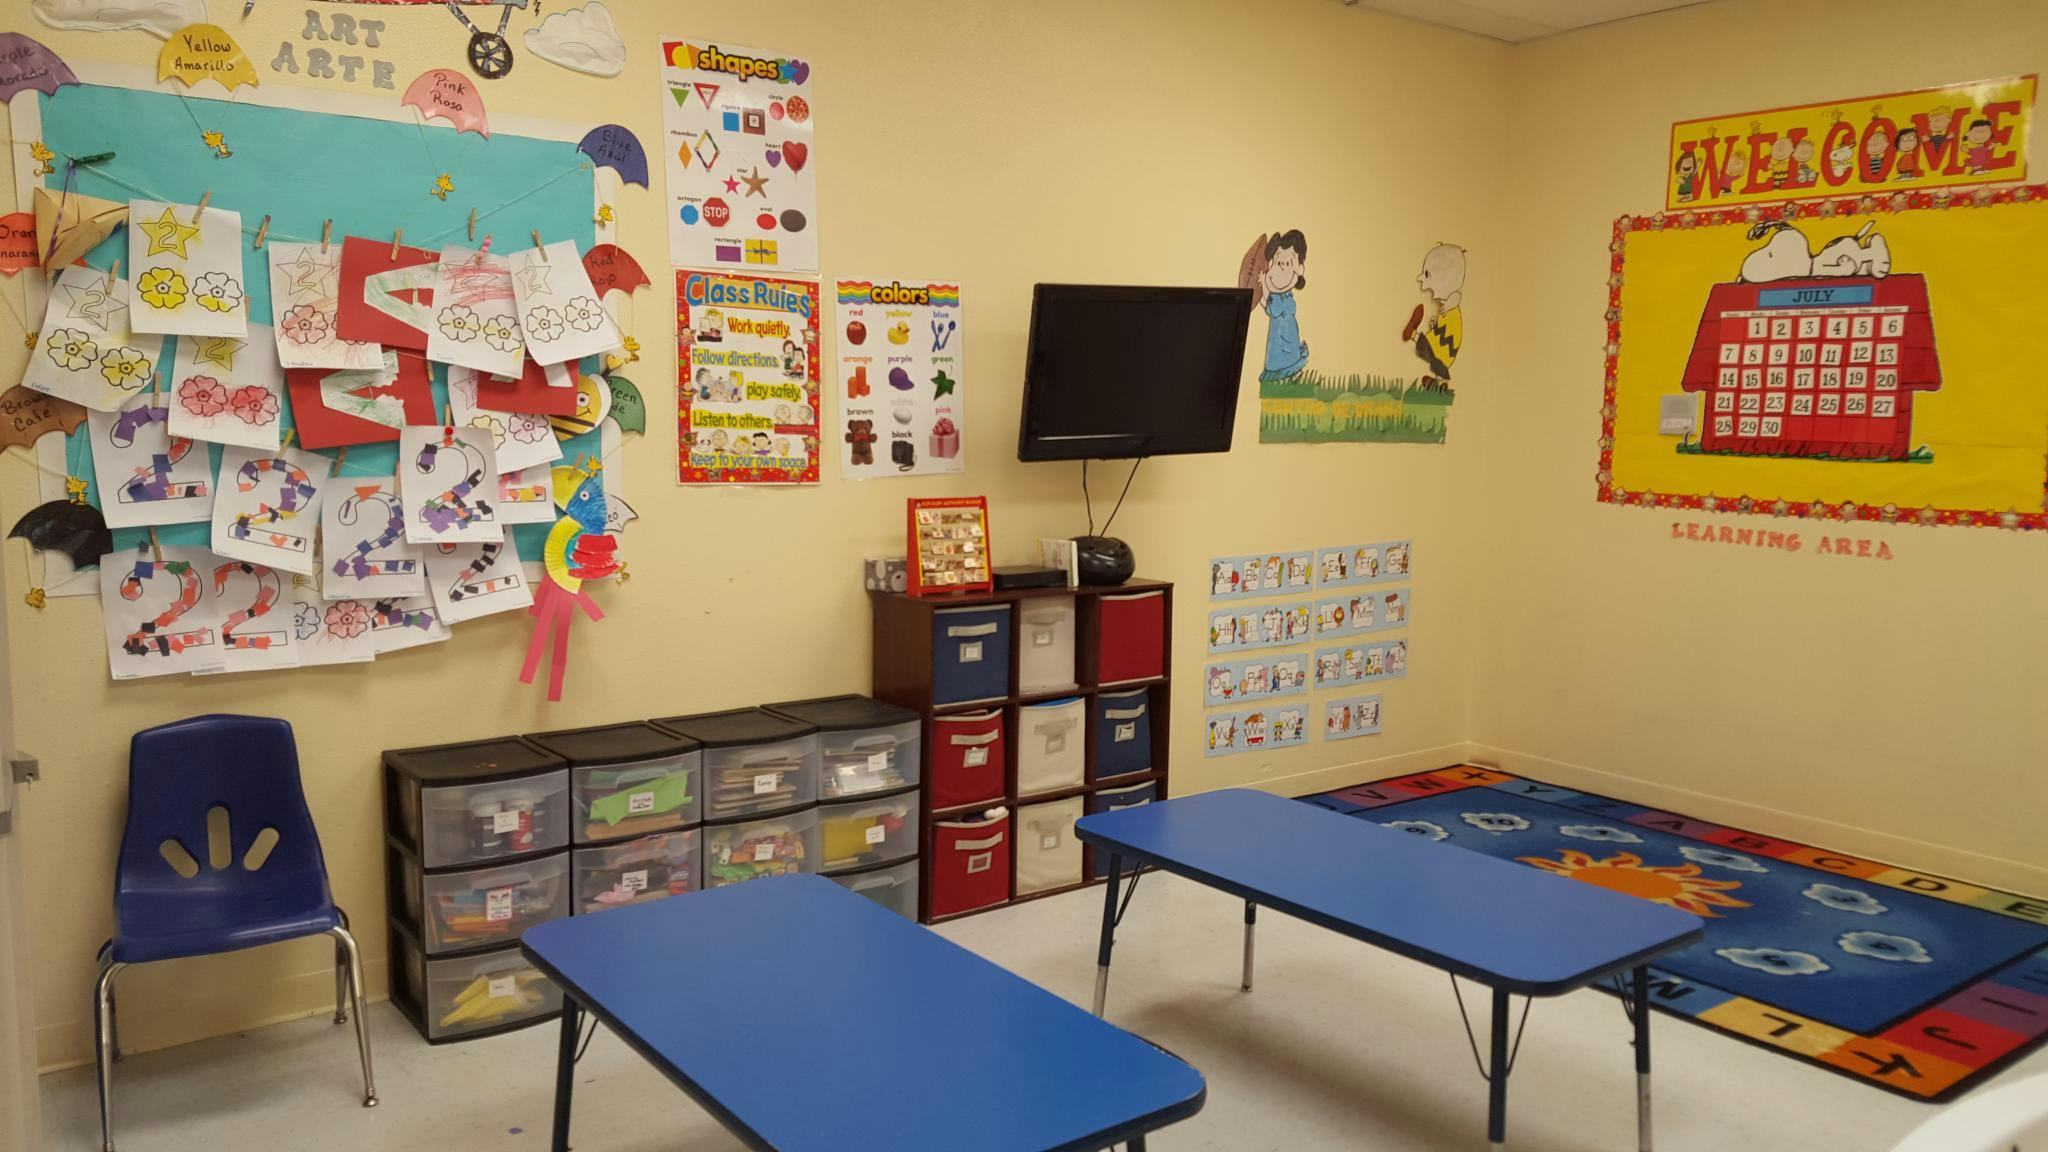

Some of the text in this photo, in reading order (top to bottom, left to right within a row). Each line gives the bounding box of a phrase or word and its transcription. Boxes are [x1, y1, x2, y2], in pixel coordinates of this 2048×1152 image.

[302, 9, 385, 47] ART
[183, 34, 232, 54] Yellow
[175, 56, 234, 72] Amarillo
[271, 42, 396, 90] ARTE
[698, 45, 780, 82] shapes
[434, 71, 466, 96] Pink
[667, 80, 691, 88] triangle
[430, 89, 463, 112] Rosa
[602, 129, 632, 152] Blue
[671, 130, 698, 138] rhombus
[1678, 101, 2022, 199] WELCOME
[704, 206, 728, 219] STOP
[157, 221, 178, 250] 2
[589, 253, 613, 266] Red
[685, 275, 750, 306] Class
[870, 281, 929, 305] colors
[1792, 289, 1835, 303] JULY
[80, 290, 106, 319] 2
[933, 310, 949, 318] blue
[728, 317, 790, 339] Work quietly.
[1755, 319, 1898, 336] 1 2 3 4 5 6
[691, 348, 779, 368] Follow directions.
[843, 354, 954, 365] orange purple green
[1725, 346, 1894, 363] 7 8 9 10 11 12 13
[1722, 371, 1897, 388] 14 15 16 17 18 19 20
[747, 382, 802, 402] play safely.
[847, 408, 874, 416] brown
[936, 406, 952, 415] pink
[1717, 394, 1893, 414] 21 22 23 24 25 26 27
[693, 411, 773, 429] Listen to others.
[1716, 420, 1780, 435] 28 29 30
[691, 453, 717, 469] Keep
[719, 455, 728, 465] to
[730, 456, 753, 471] your
[755, 458, 776, 467] own
[1671, 522, 1894, 560] LEARNING AREA
[1352, 771, 1492, 800] V W X
[1481, 818, 1514, 826] 10
[1646, 820, 1686, 831] A
[1728, 836, 1769, 849] B
[1813, 857, 1856, 870] C
[1901, 877, 1949, 892] D
[2005, 902, 2048, 920] E
[1762, 1013, 1803, 1038] L
[1923, 1026, 1979, 1052] J
[1850, 1050, 1925, 1079] K
